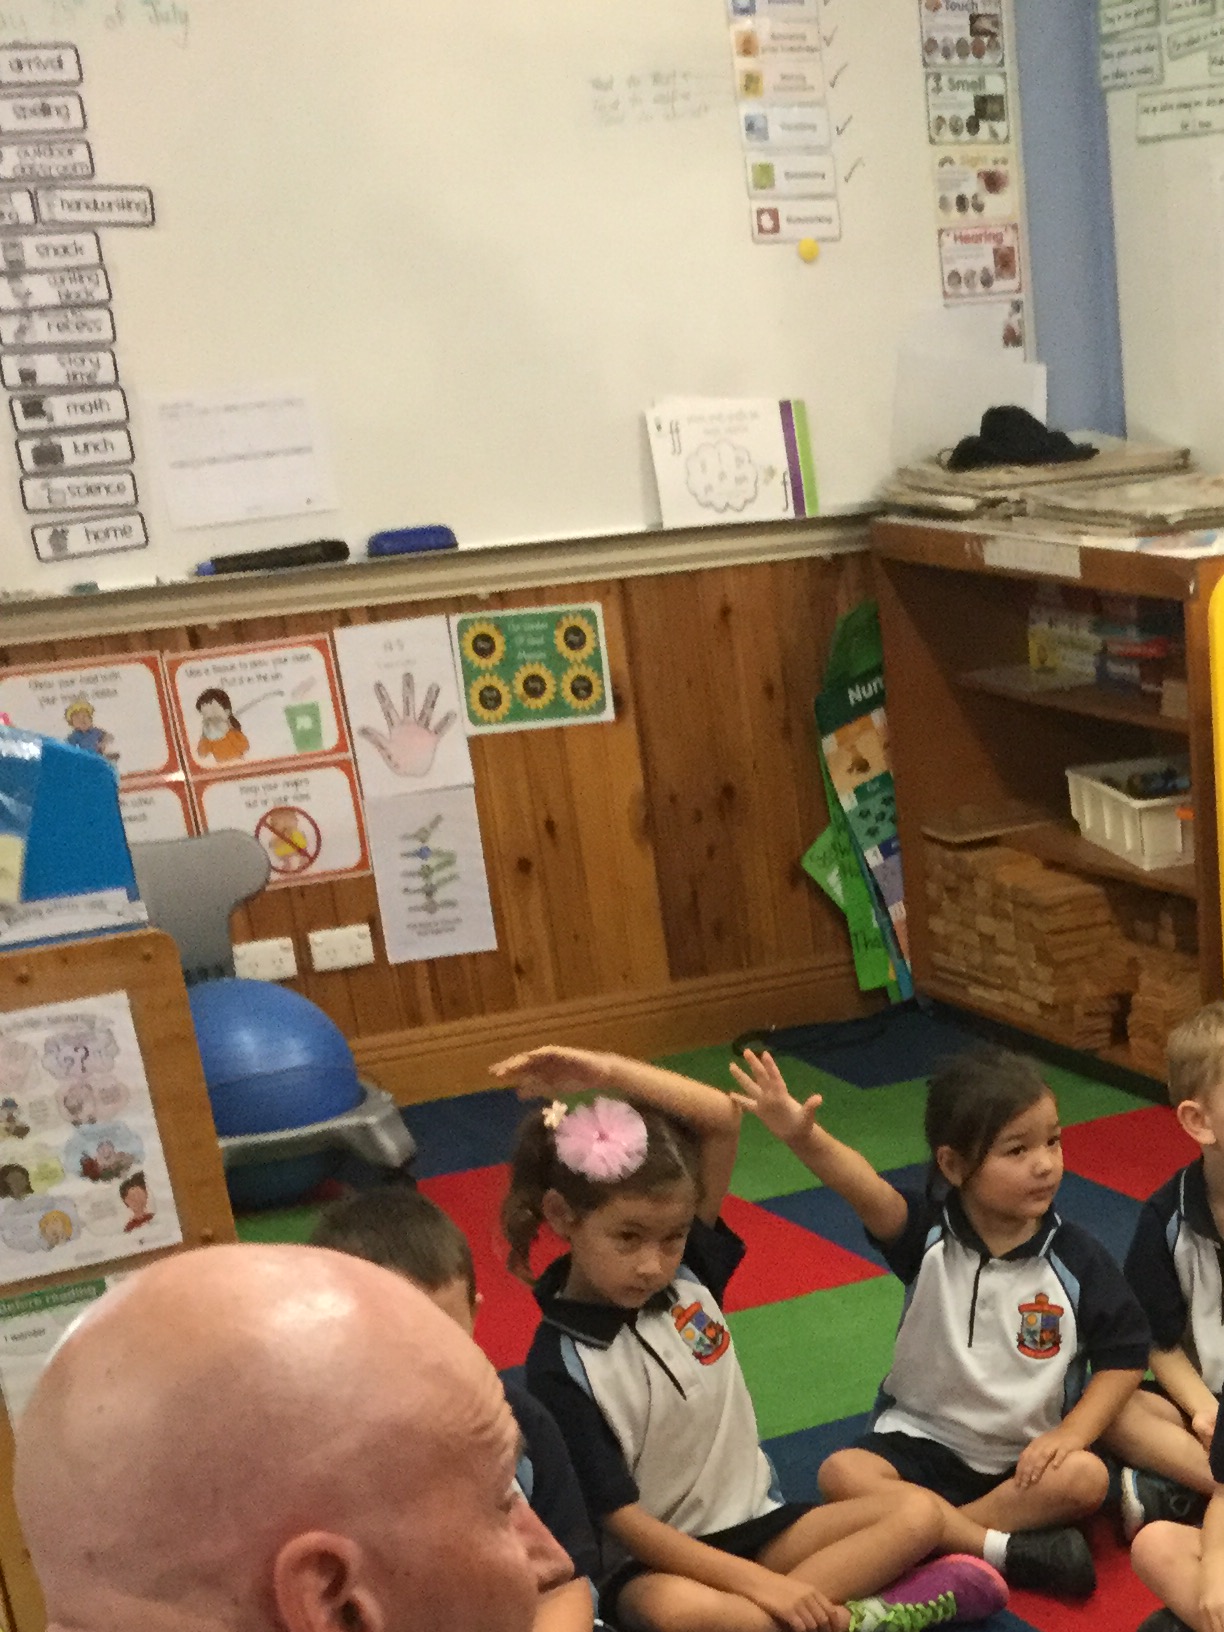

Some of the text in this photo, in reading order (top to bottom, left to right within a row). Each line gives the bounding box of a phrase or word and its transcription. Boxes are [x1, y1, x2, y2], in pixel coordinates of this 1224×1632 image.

[948, 75, 985, 92] Smell
[60, 197, 149, 217] handwriting
[72, 438, 115, 456] lunch
[66, 482, 126, 498] science
[84, 525, 133, 544] home
